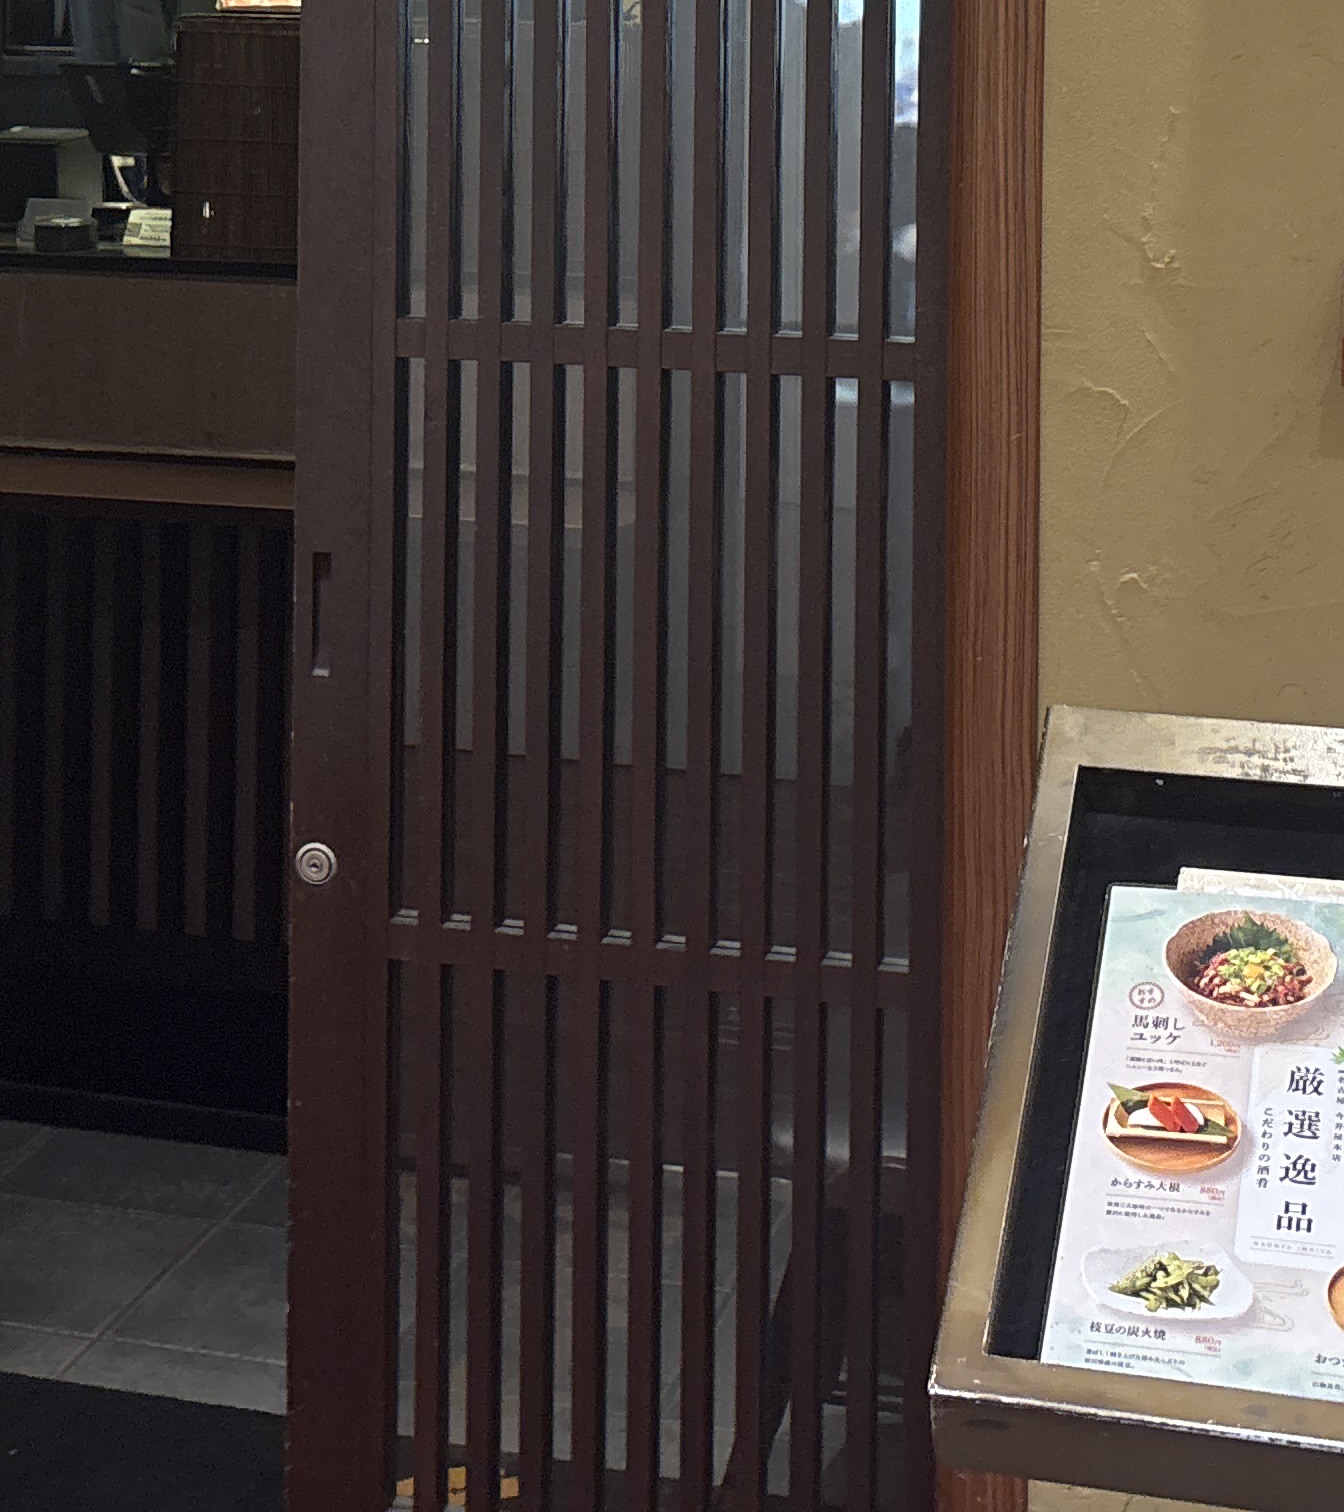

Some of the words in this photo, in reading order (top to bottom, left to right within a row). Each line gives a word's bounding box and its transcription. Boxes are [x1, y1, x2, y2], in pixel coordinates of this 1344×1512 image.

[1131, 1013, 1186, 1031] 馬刺し
[1130, 1031, 1182, 1046] ユッケ
[1276, 1065, 1325, 1234] 厳選逸品
[1110, 1177, 1181, 1193] からすみ大根
[1089, 1320, 1167, 1341] 枝豆の炭火焼
